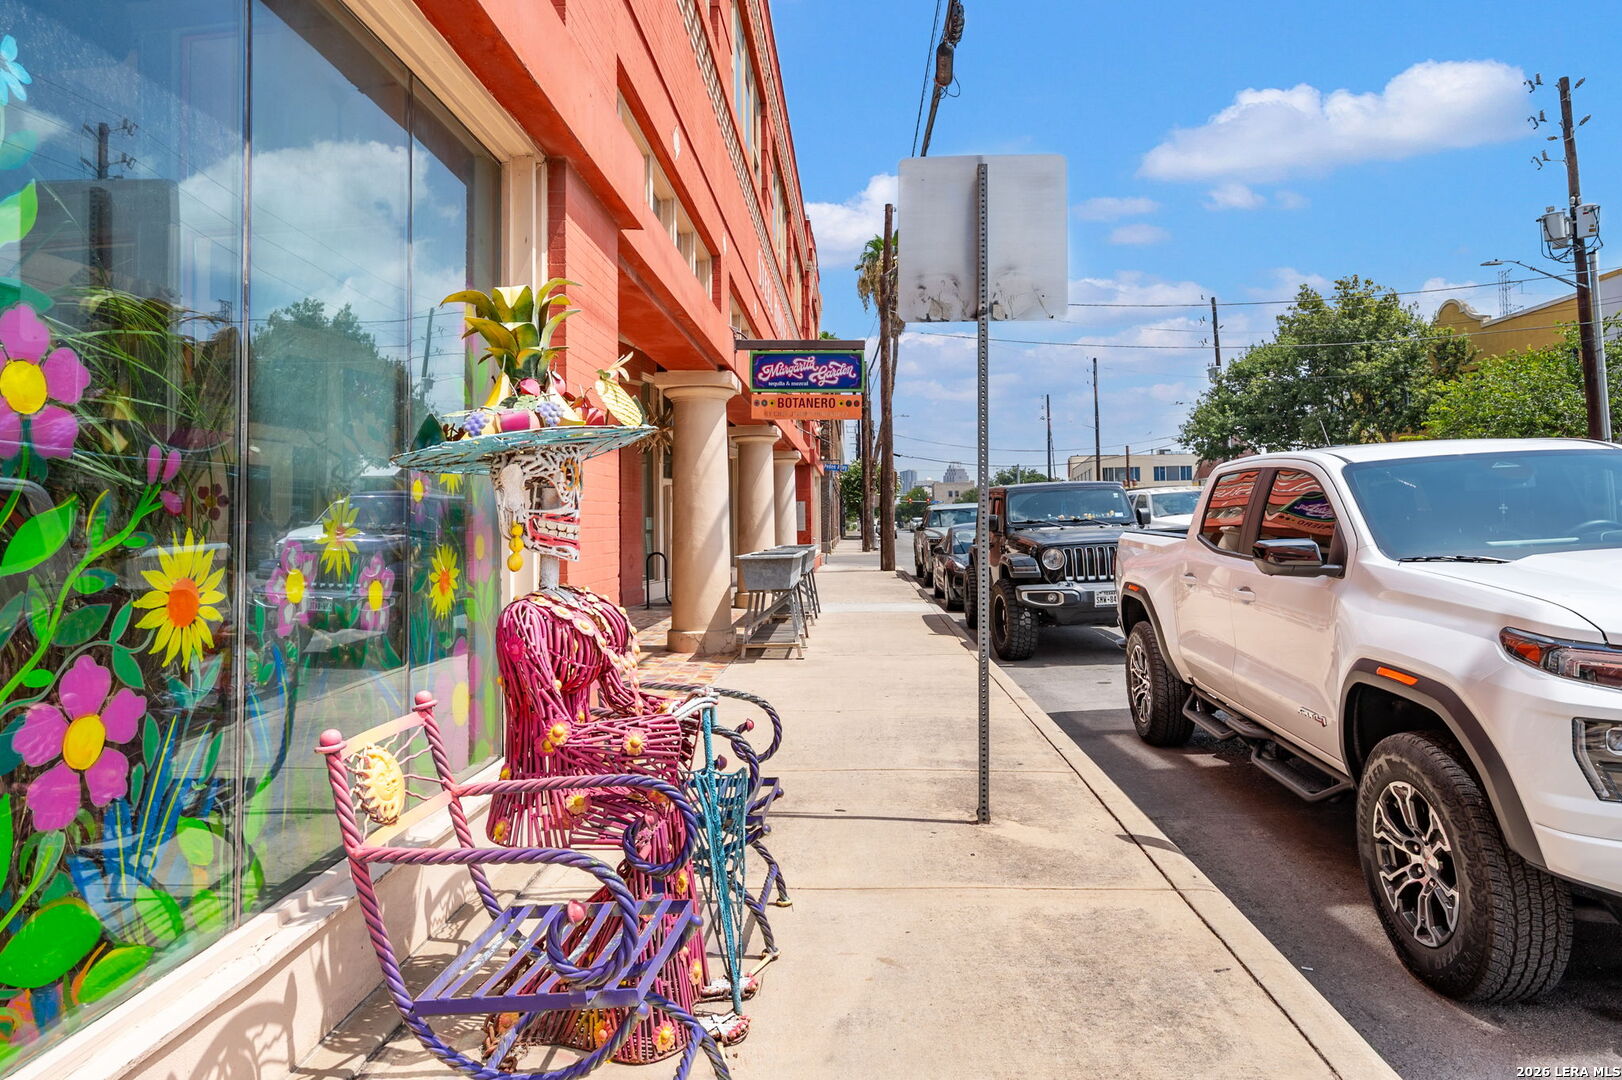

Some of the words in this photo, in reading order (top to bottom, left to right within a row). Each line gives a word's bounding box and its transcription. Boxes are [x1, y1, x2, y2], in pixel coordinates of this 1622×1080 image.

[758, 356, 819, 381] Margarita
[808, 361, 856, 386] Garden
[777, 397, 836, 409] BOTANERO
